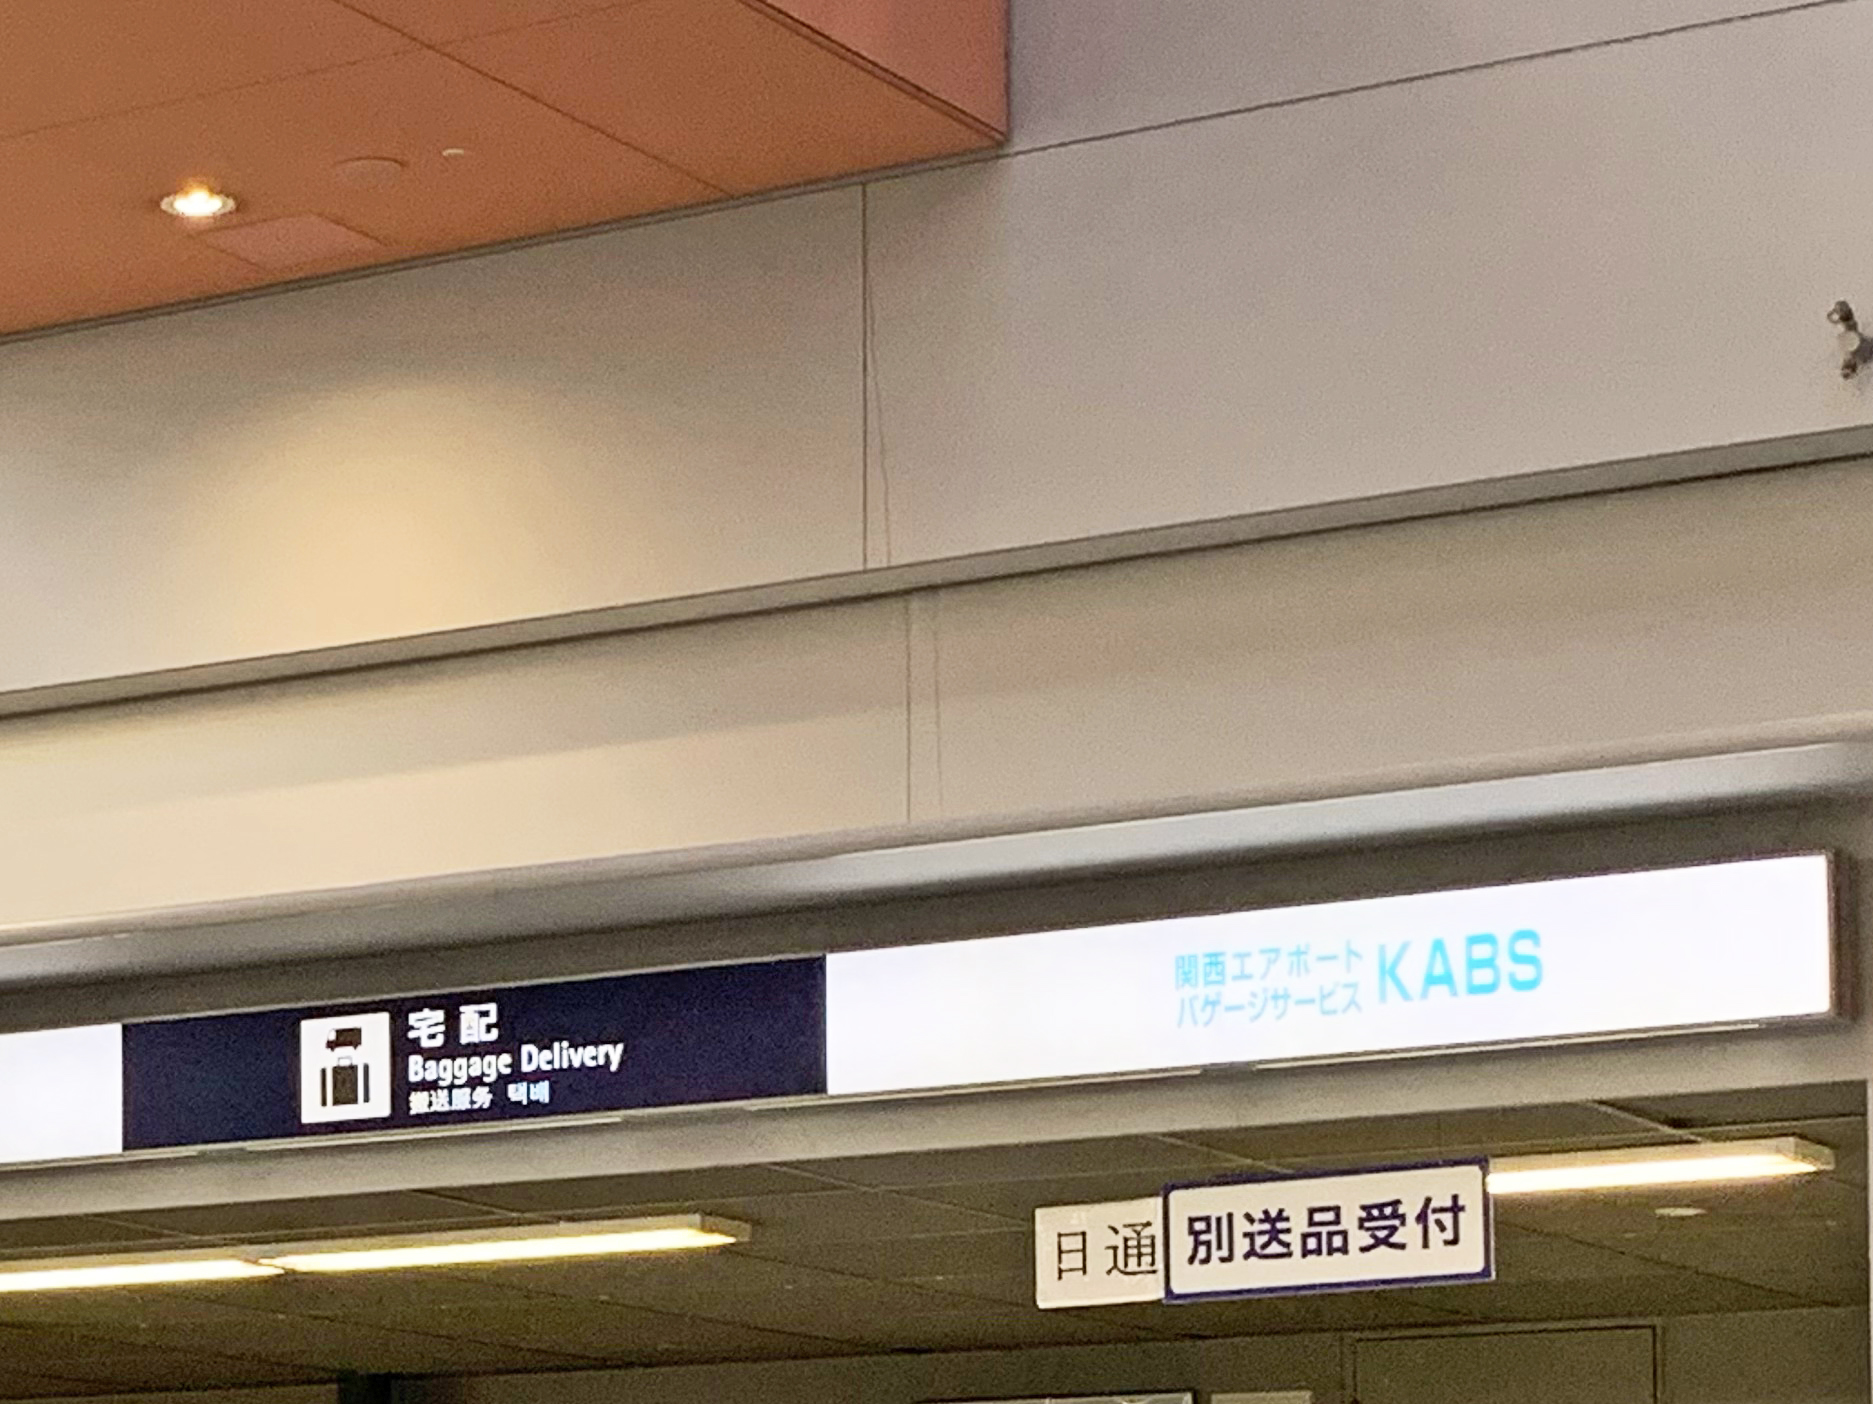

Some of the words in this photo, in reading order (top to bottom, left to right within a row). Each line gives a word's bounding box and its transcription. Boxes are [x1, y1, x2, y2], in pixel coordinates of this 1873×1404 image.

[1378, 929, 1543, 1004] KABS
[407, 1002, 499, 1048] 宅配
[408, 1053, 512, 1087] Baggage
[521, 1040, 624, 1072] Delivery
[1054, 1221, 1159, 1282] 日通
[1185, 1194, 1466, 1267] 別送品受付
